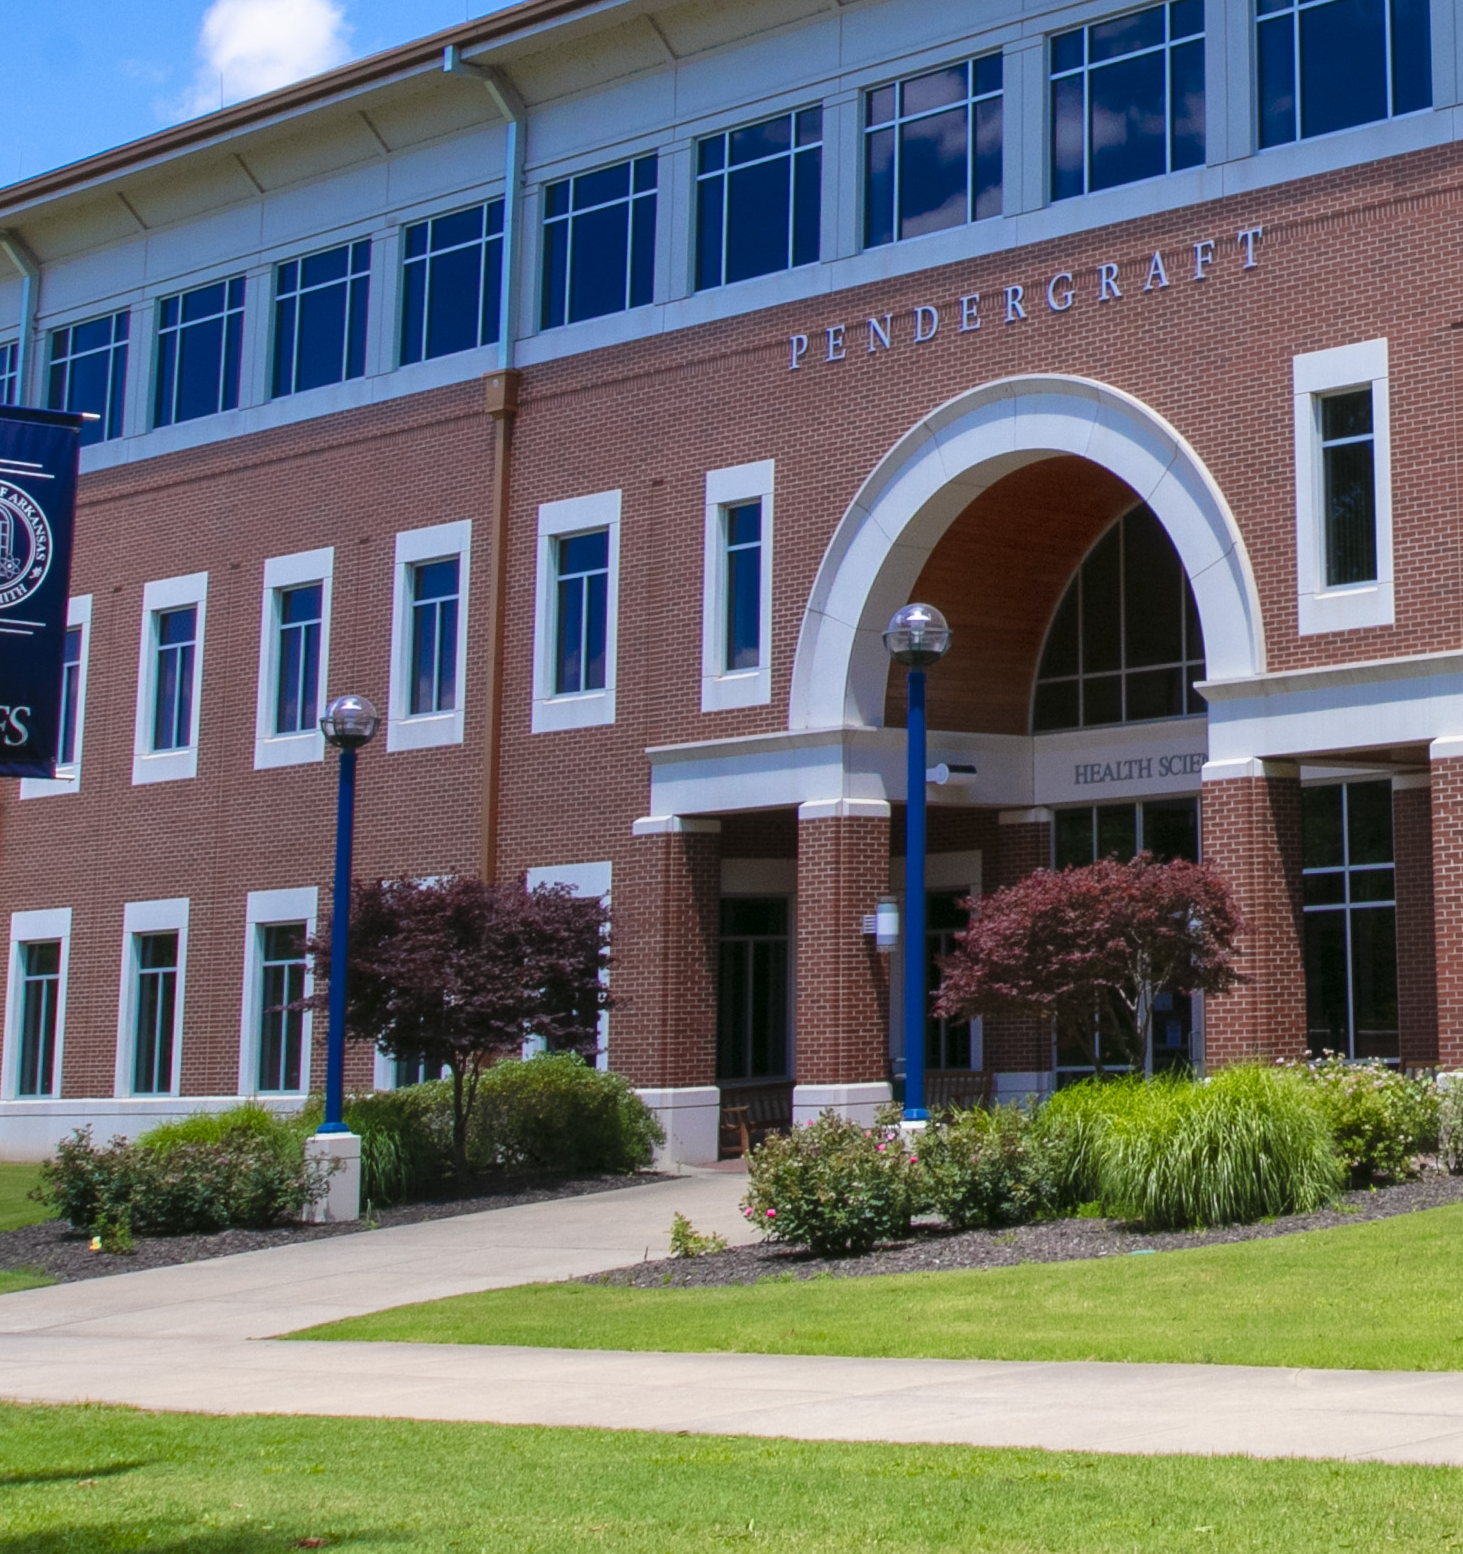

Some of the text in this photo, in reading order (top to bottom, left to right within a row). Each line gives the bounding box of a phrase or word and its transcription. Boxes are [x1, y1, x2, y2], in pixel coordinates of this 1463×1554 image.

[788, 227, 1263, 370] PENDERGRAFT
[9, 493, 47, 562] ARKANSAS
[1073, 757, 1154, 785] HEALTH
